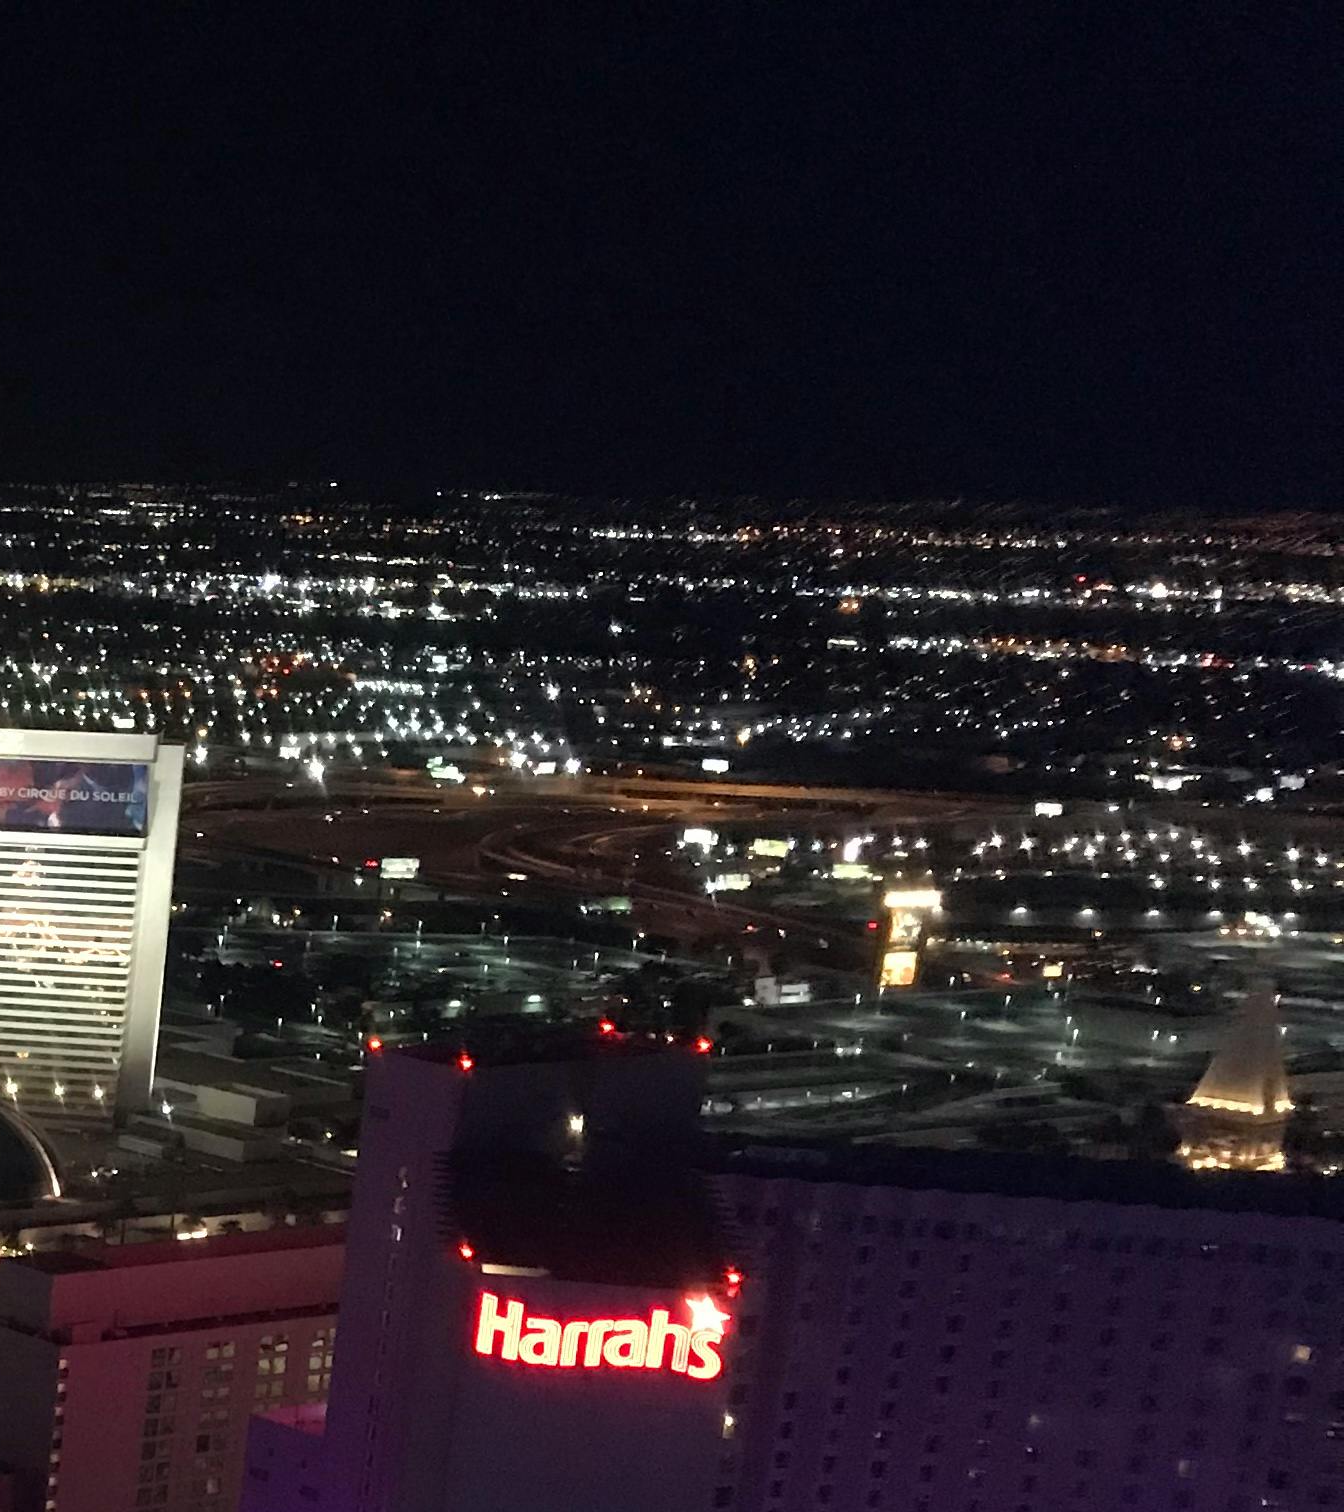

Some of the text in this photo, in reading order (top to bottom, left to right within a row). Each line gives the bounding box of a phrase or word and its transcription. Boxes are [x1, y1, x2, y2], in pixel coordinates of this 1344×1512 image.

[18, 788, 66, 802] CIRQUE
[70, 790, 89, 801] DU
[92, 791, 138, 803] SOLEIL
